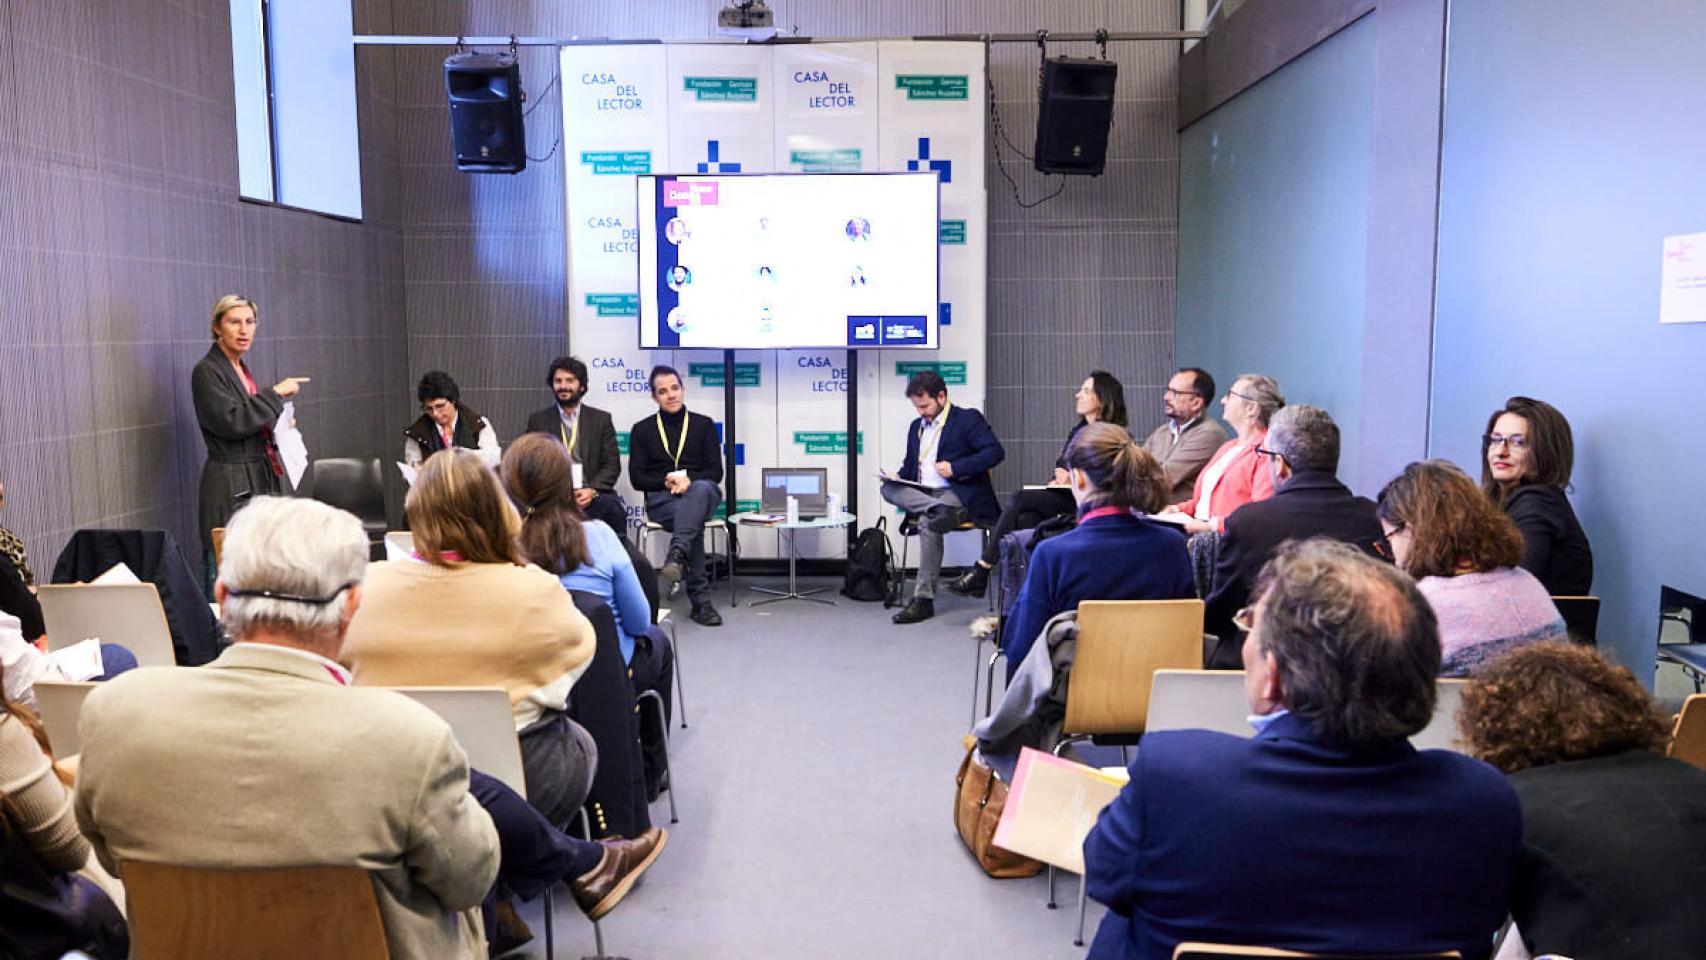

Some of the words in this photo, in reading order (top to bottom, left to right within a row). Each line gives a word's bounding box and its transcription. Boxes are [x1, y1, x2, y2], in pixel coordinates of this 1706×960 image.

[582, 74, 616, 85] CASA
[794, 72, 829, 83] CASA
[616, 85, 638, 96] DEL
[829, 83, 851, 93] DEL
[598, 99, 642, 110] LECTOR
[810, 97, 855, 108] LECTOR
[588, 217, 622, 228] CASA
[622, 229, 638, 240] DE
[603, 242, 638, 253] LECTO
[592, 358, 625, 368] CASA
[798, 356, 831, 368] CASA
[625, 369, 646, 379] DEL
[832, 368, 848, 379] DE
[607, 382, 650, 392] LECTOR
[812, 381, 848, 392] LECTO
